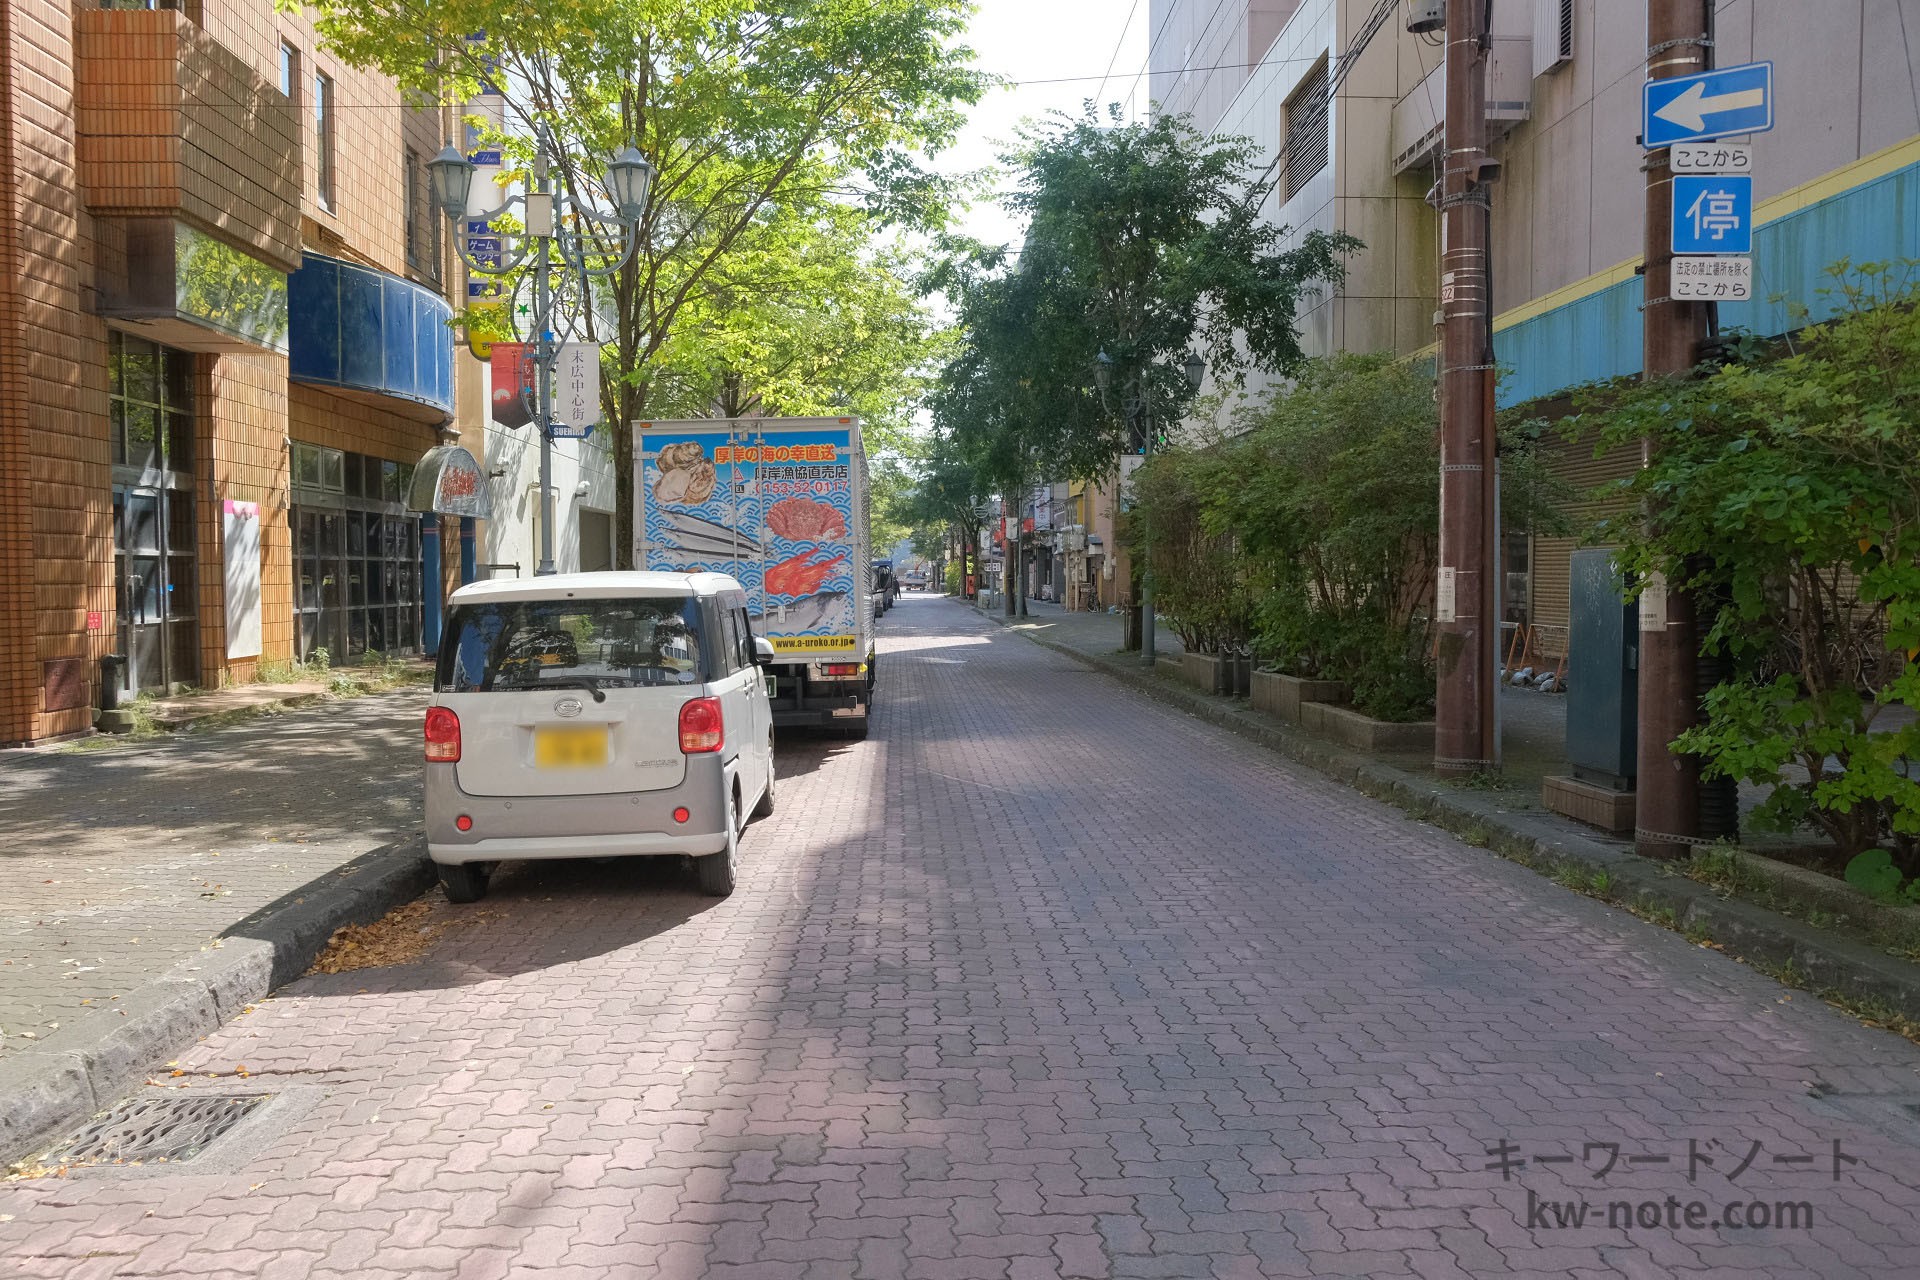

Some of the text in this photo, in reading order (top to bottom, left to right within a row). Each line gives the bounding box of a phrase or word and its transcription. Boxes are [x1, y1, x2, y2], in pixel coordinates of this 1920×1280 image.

[1676, 150, 1748, 168] ここから
[1685, 189, 1740, 240] 停
[469, 240, 494, 250] ゲーム
[1676, 261, 1749, 277] 法定の禁止場所を除く
[1677, 281, 1747, 297] ここから
[570, 349, 585, 421] 末広中心街
[715, 444, 836, 463] 厚岸の海の幸直送
[755, 465, 848, 480] 厚岸漁協直売店
[775, 638, 849, 649] www.a-uroko.or.jp
